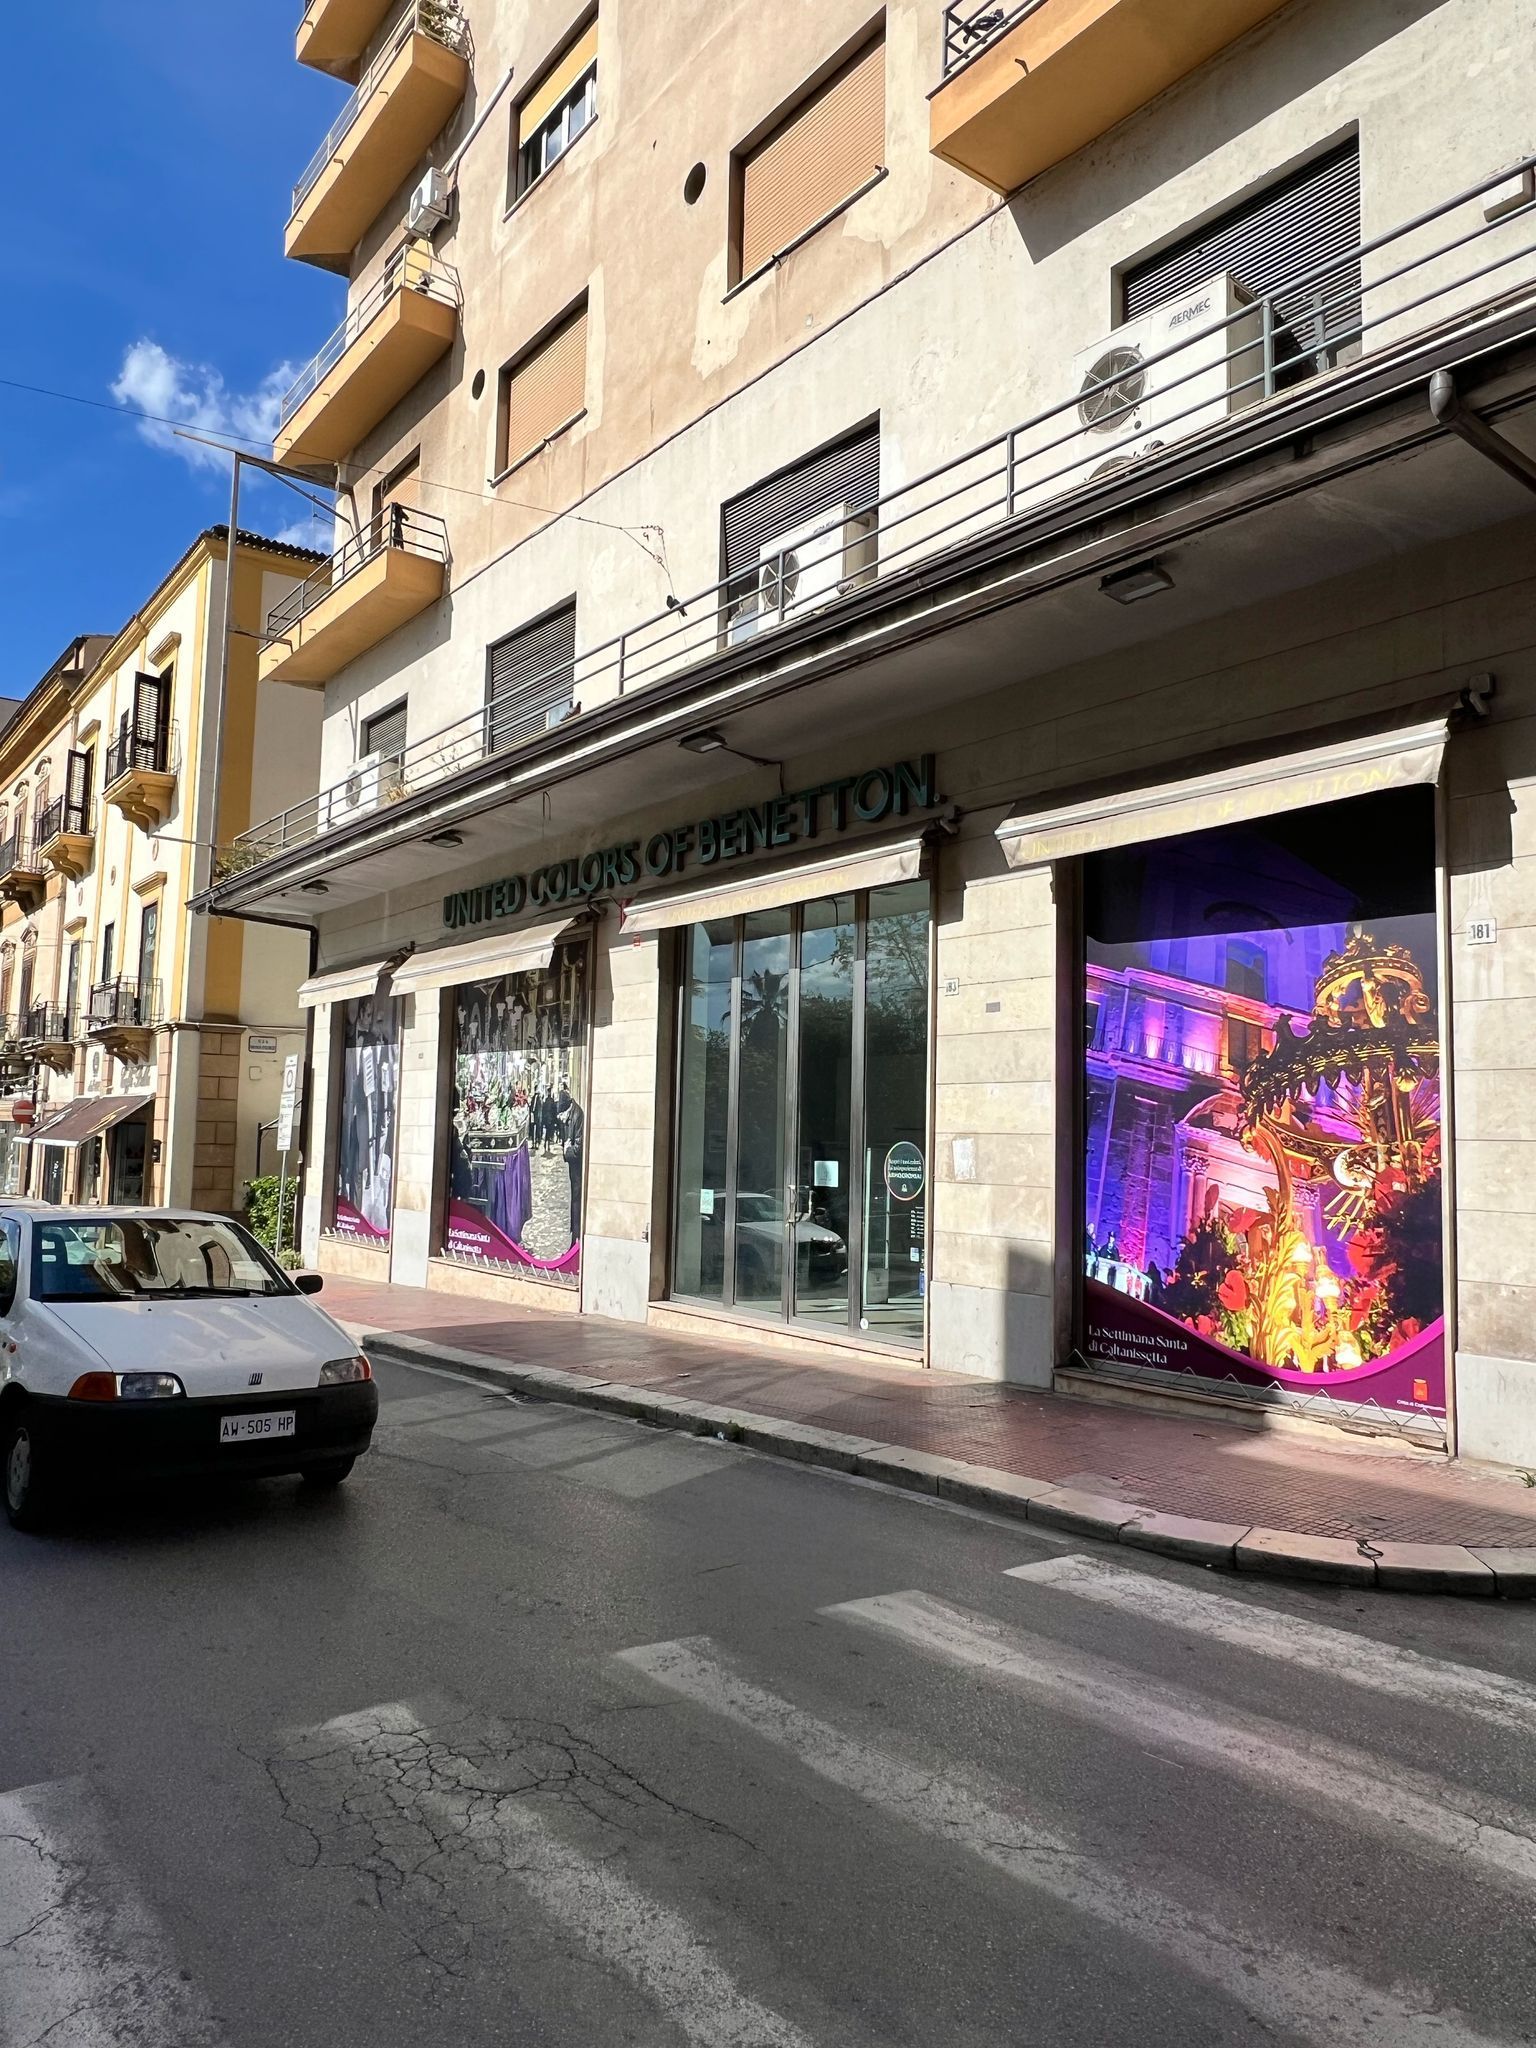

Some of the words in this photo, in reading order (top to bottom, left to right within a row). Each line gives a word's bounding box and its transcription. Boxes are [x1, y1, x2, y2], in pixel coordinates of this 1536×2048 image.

[1169, 298, 1211, 328] AERMEC
[442, 876, 526, 929] UNITED
[529, 843, 640, 905] COLORS
[645, 825, 694, 877] OF
[1471, 924, 1490, 939] 181
[1088, 1324, 1101, 1337] La
[1102, 1327, 1155, 1346] Settimana
[1156, 1335, 1188, 1351] Santa
[1088, 1339, 1098, 1352] di
[1099, 1342, 1168, 1364] Caltanissetta
[278, 1416, 294, 1431] HP
